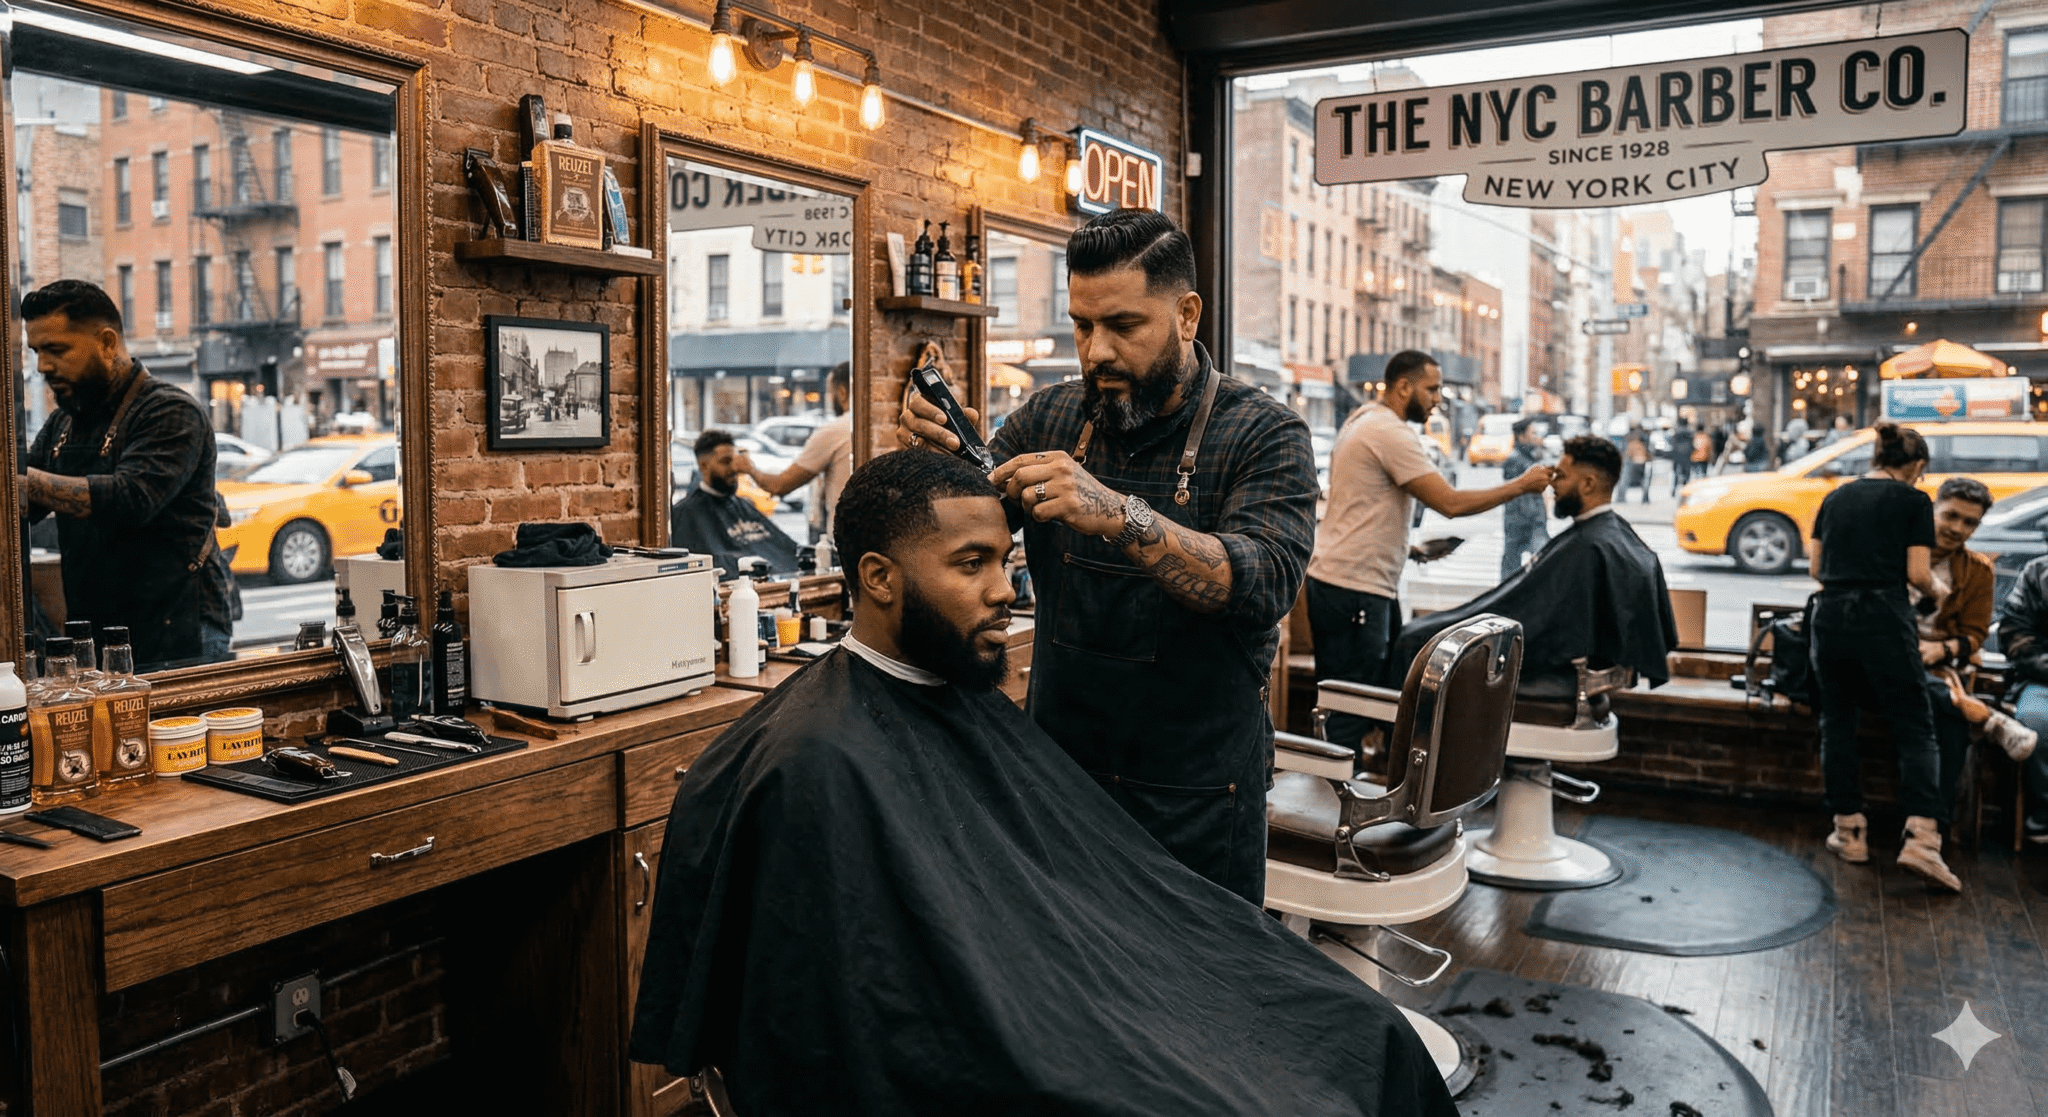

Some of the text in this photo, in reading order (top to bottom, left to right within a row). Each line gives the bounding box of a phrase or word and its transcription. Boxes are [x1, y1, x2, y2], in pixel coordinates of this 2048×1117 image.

[1332, 45, 1947, 158] THE NYC BARBER CO.
[1548, 140, 1670, 165] SINCE 1928
[558, 155, 594, 176] REUZEL
[1085, 143, 1157, 210] OPEN
[1484, 157, 1740, 200] NEW YORK CITY
[55, 709, 90, 726] REUZEL
[114, 697, 146, 714] REUZEL
